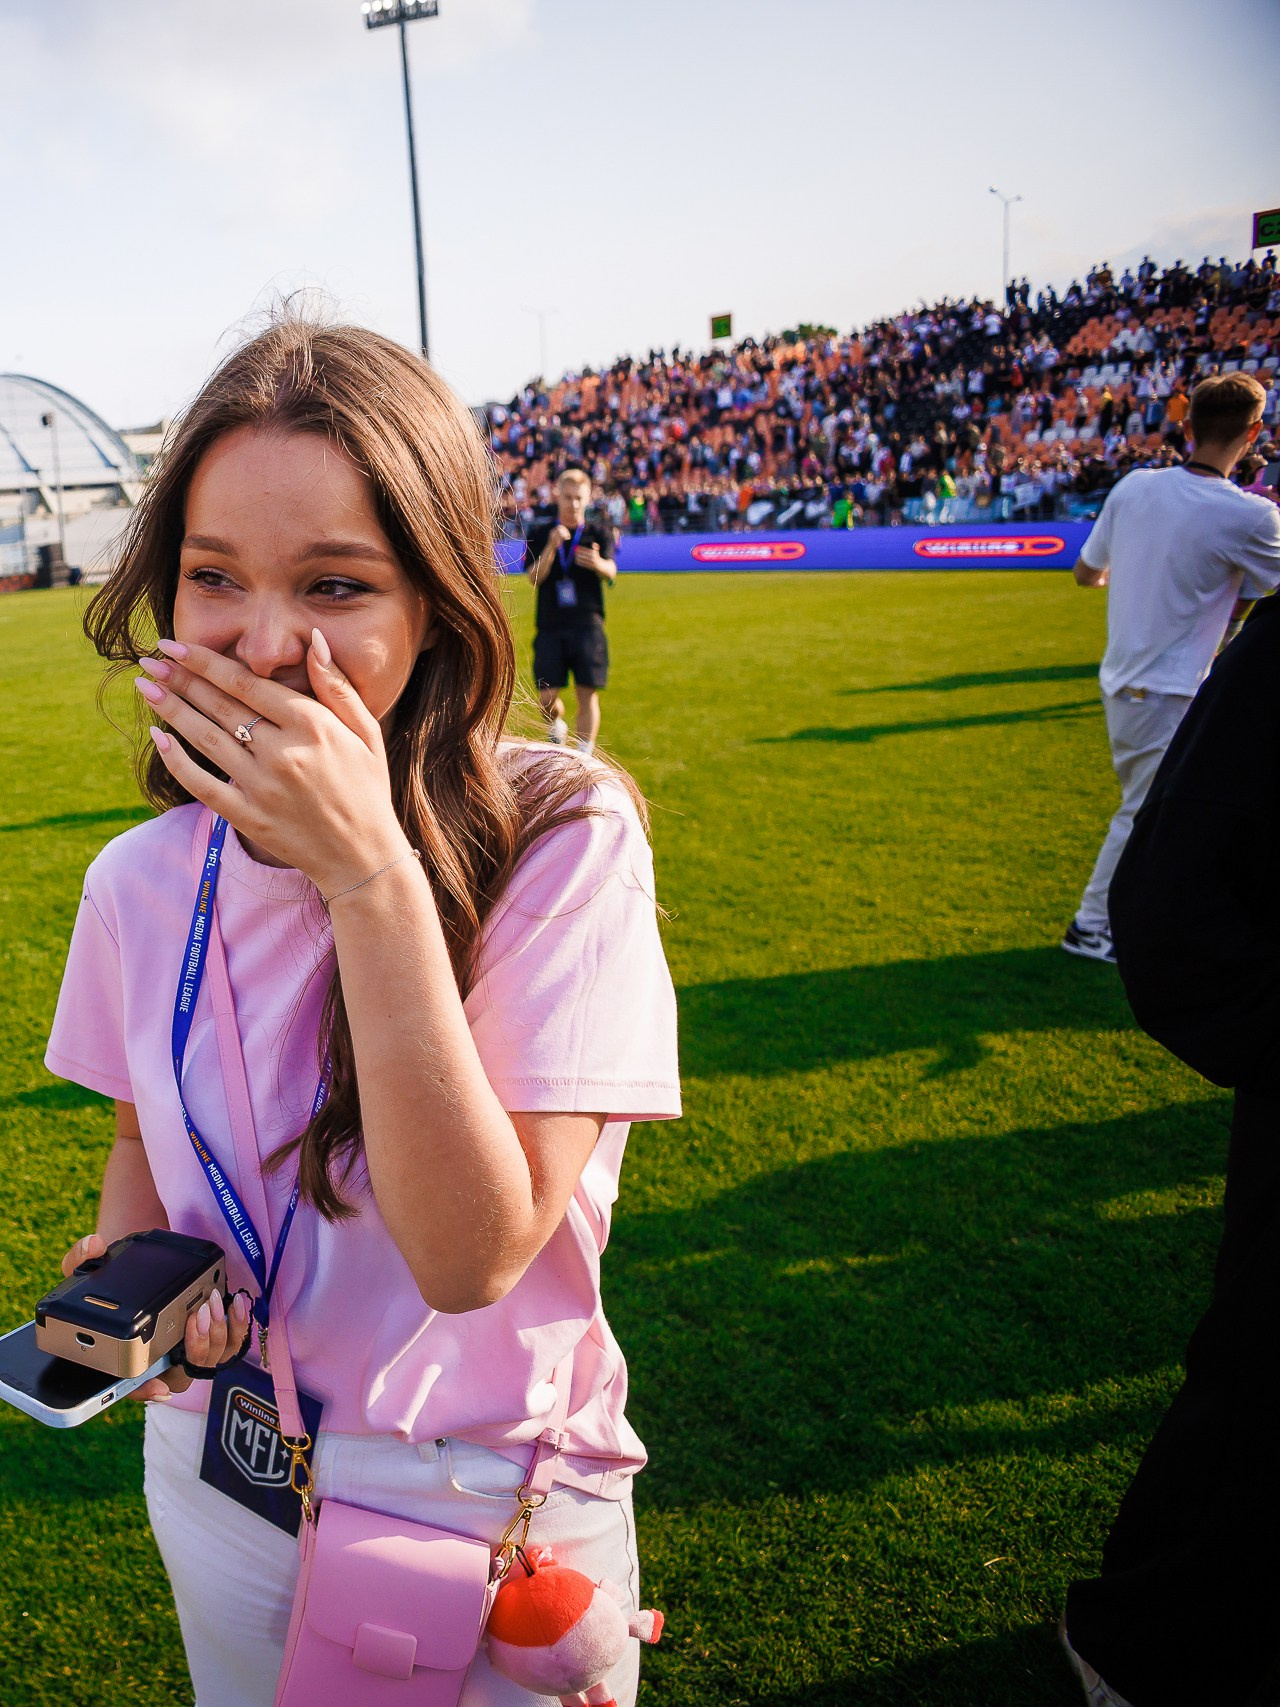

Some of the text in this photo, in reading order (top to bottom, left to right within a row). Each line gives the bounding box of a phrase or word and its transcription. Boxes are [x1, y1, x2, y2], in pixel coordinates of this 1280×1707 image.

[179, 847, 219, 1013] MFL WINLINE MEDIA FOOTBALL LEAGUE
[190, 1130, 211, 1164] WINLINE
[207, 1163, 225, 1191] MEDIA
[220, 1188, 244, 1232] FOOTBALL
[239, 1227, 261, 1260] LEAGUE
[229, 1409, 286, 1480] MFL
[239, 1398, 276, 1424] Winline
